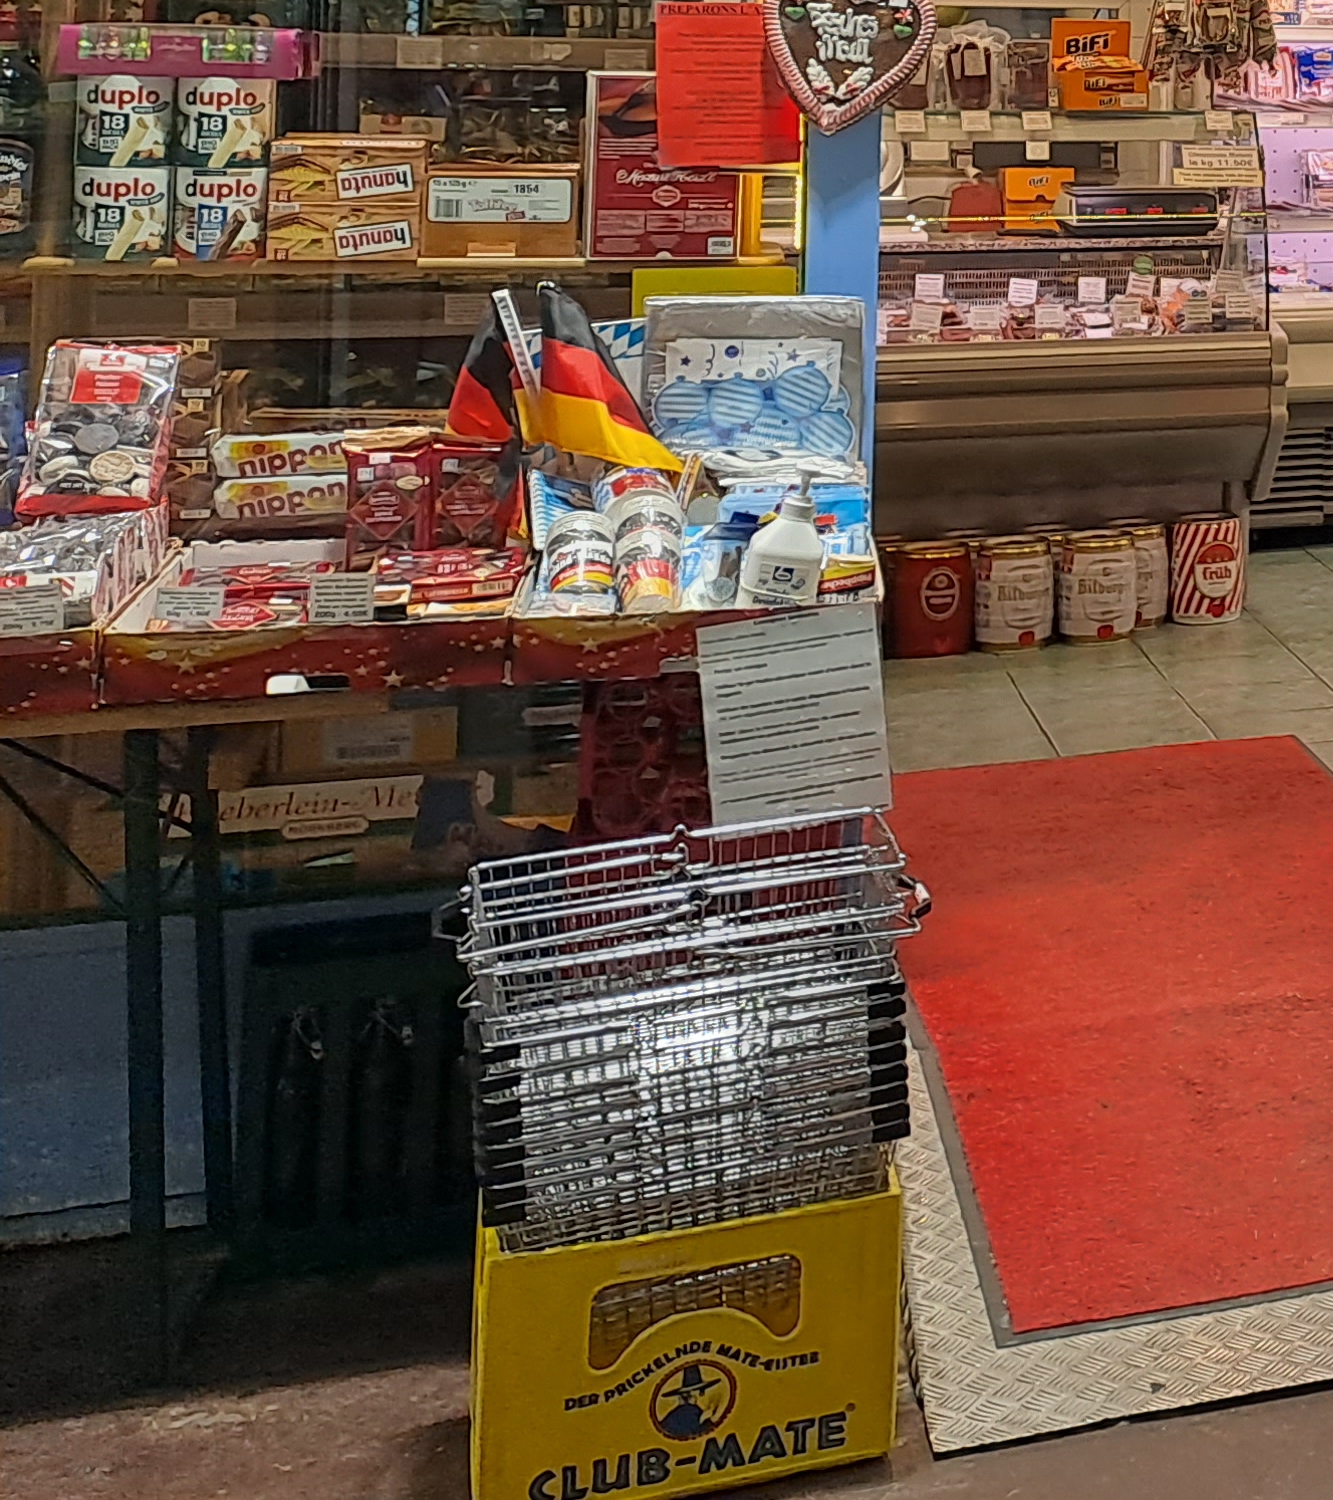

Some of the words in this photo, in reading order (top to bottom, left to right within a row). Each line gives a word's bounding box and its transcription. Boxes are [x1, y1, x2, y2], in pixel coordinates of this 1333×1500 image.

[1065, 30, 1113, 55] BiFi
[87, 84, 160, 110] duplo
[186, 87, 257, 111] duplo
[101, 115, 125, 130] 18
[200, 116, 223, 131] 18
[82, 177, 155, 202] duplo
[185, 178, 258, 203] duplo
[341, 170, 409, 194] hanuta
[97, 208, 121, 222] 18
[200, 208, 223, 222] 18
[337, 226, 407, 250] hanuta
[238, 439, 345, 477] nippon
[238, 481, 345, 517] nippon
[563, 1391, 601, 1412] DER
[603, 1339, 713, 1404] PRICKELNDE
[528, 1410, 849, 1500] CLUB-MATE
